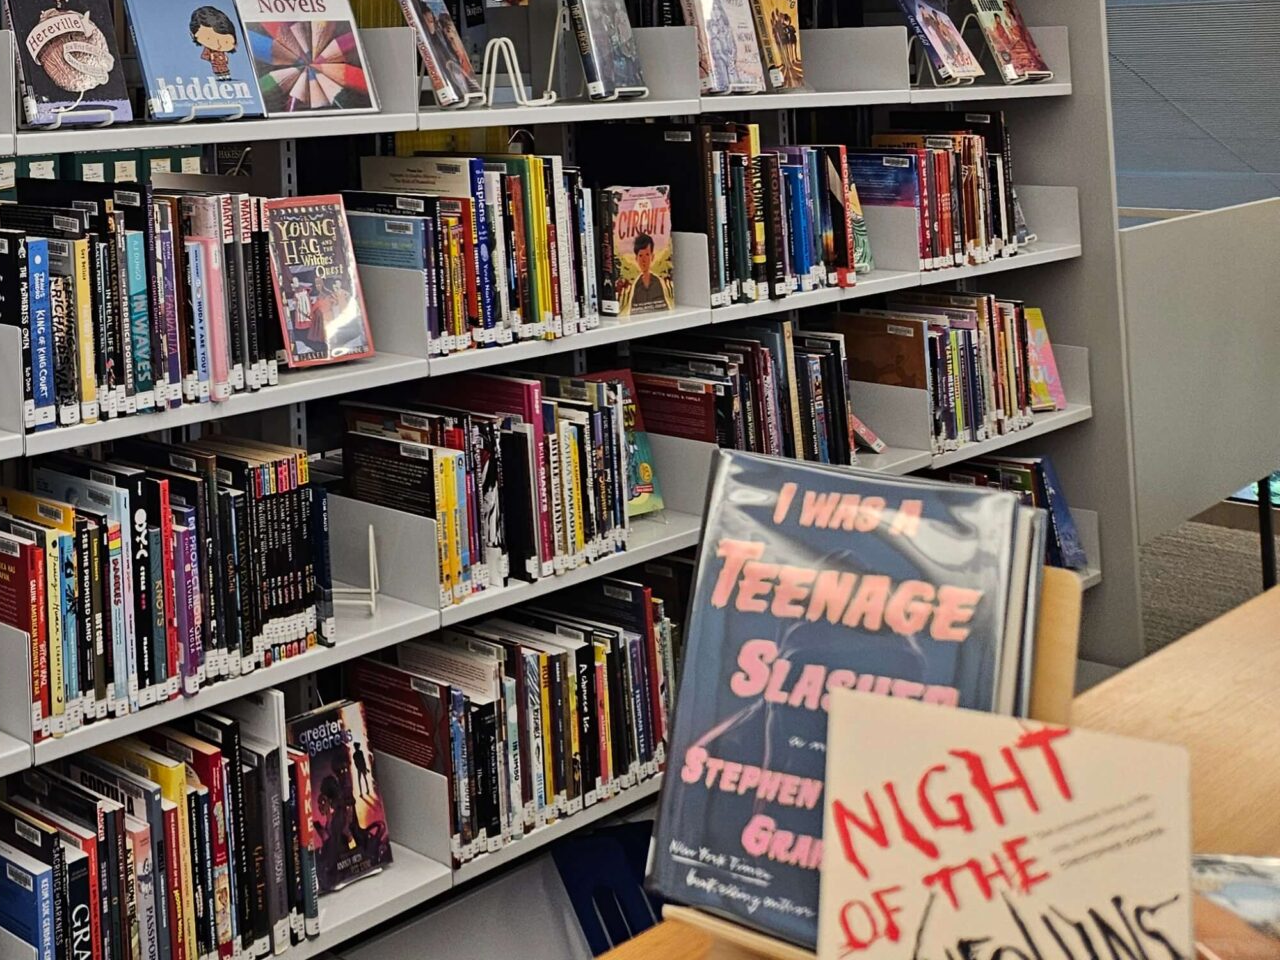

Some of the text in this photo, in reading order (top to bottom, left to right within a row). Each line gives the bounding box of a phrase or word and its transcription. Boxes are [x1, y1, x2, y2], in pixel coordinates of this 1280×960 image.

[28, 18, 83, 51] Hereville
[157, 75, 251, 101] hidden
[222, 197, 233, 240] MARVEL
[240, 199, 251, 242] MARVEL
[476, 177, 487, 223] Sapiens
[770, 158, 782, 258] FROM HELL
[276, 219, 337, 241] YOUNG
[619, 207, 668, 241] CIRCUIT
[280, 239, 320, 266] HAG
[315, 264, 344, 280] Quest
[35, 310, 48, 399] KING KING COURT
[133, 294, 151, 382] IN WAVES
[773, 482, 924, 539] I WAS A
[189, 536, 200, 594] PROJECT
[226, 553, 235, 593] CORALINE
[155, 579, 163, 627] KNOTS
[710, 539, 984, 641] TEENAGE
[299, 719, 343, 742] greater
[635, 689, 643, 732] FRESHMAN
[300, 761, 313, 832] WAKE
[681, 746, 823, 809] STEPHEN
[831, 726, 1073, 880] NIGHT
[41, 878, 50, 915] KEUM SUK
[53, 847, 63, 946] SACRIFICE DARKNESS
[830, 885, 904, 958] OF
[921, 837, 1051, 911] THE
